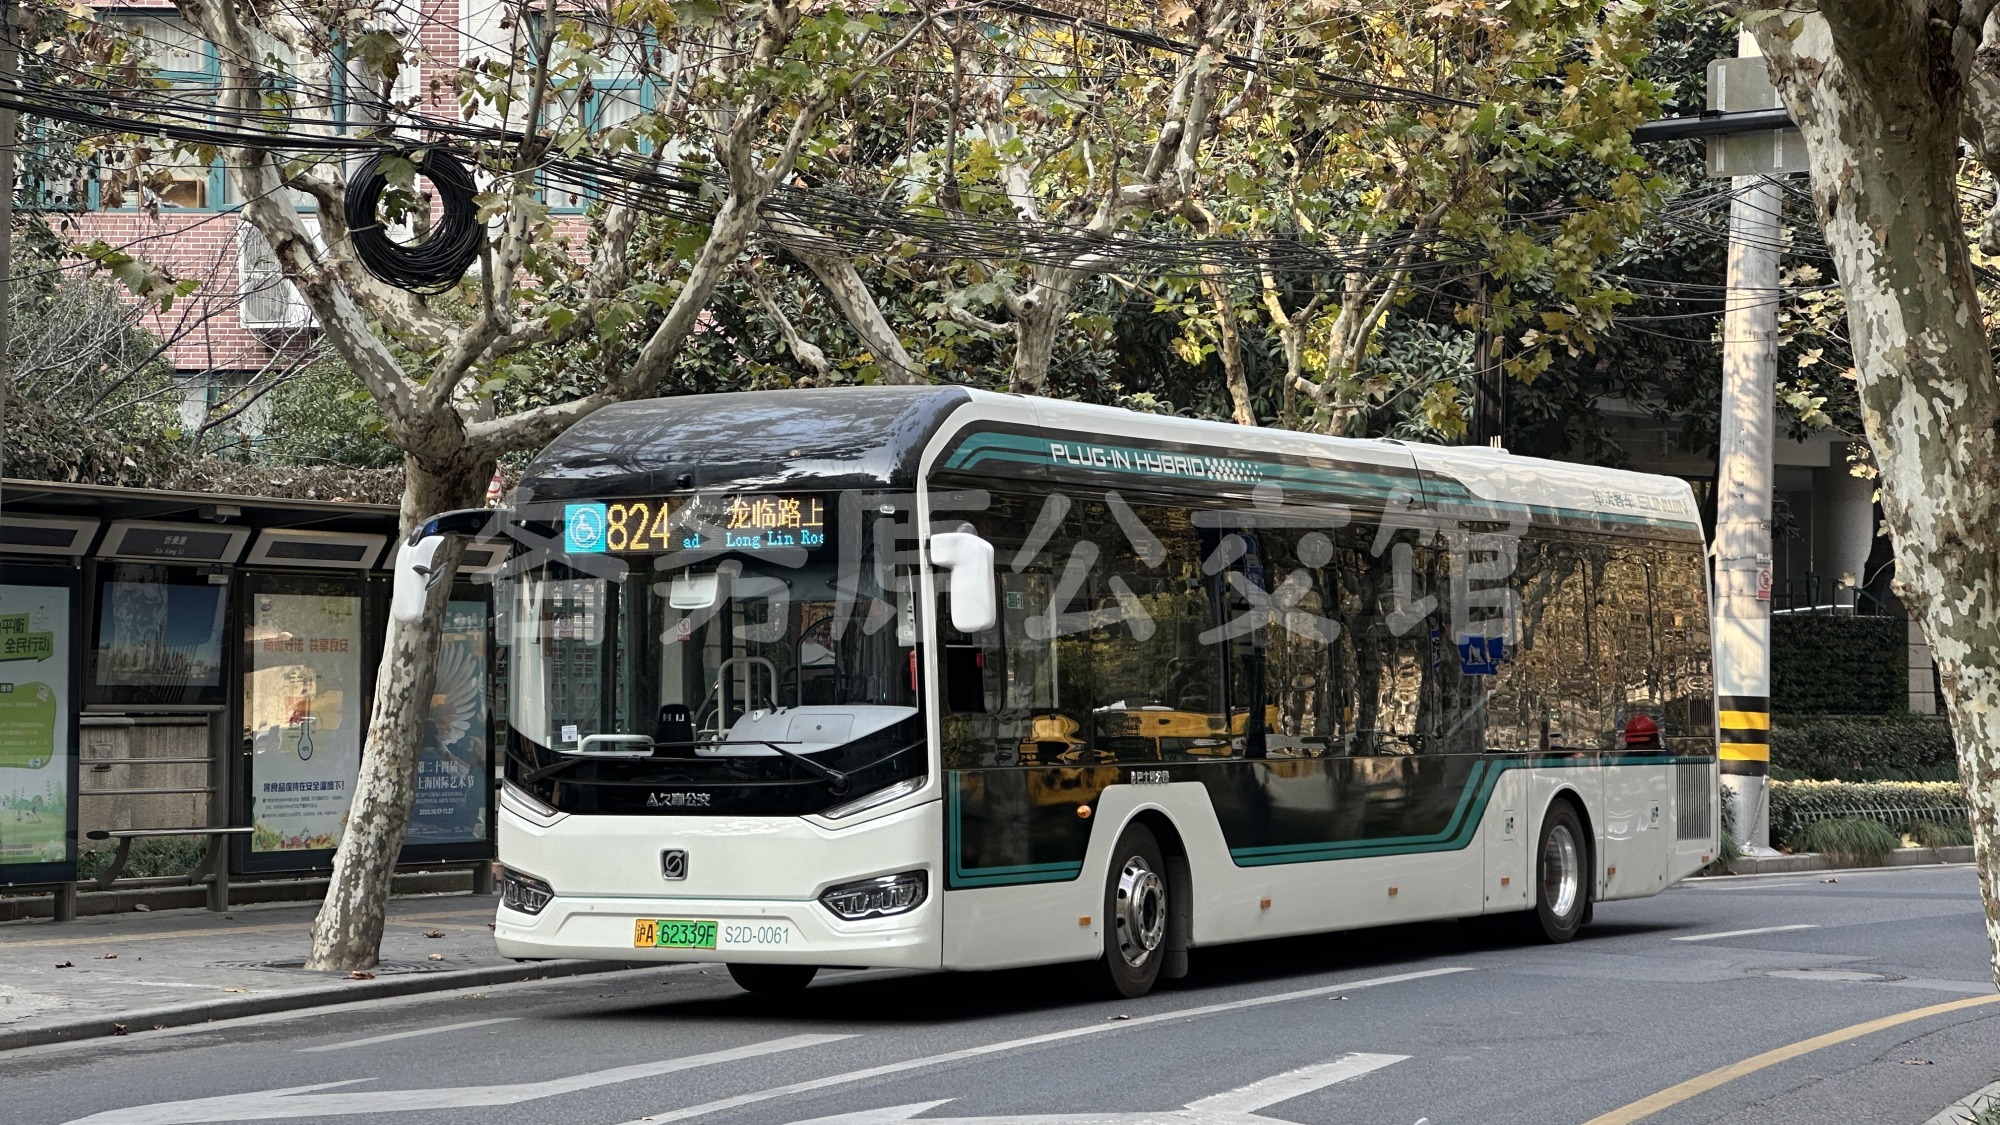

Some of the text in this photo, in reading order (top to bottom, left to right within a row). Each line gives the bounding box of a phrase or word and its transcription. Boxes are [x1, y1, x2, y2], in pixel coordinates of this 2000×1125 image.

[1050, 443, 1206, 477] PLUG-IN HYBRID
[727, 497, 824, 529] 龙临路上
[1637, 495, 1690, 516] SUNWIN
[607, 503, 671, 551] 824
[683, 533, 700, 549] ad
[725, 532, 761, 549] Long
[767, 531, 795, 546] Lin
[0, 618, 25, 634] 平衡
[4, 636, 50, 653] 全民行动
[416, 775, 475, 790] 上海国际艺术节
[724, 926, 789, 945] S2D-0061
